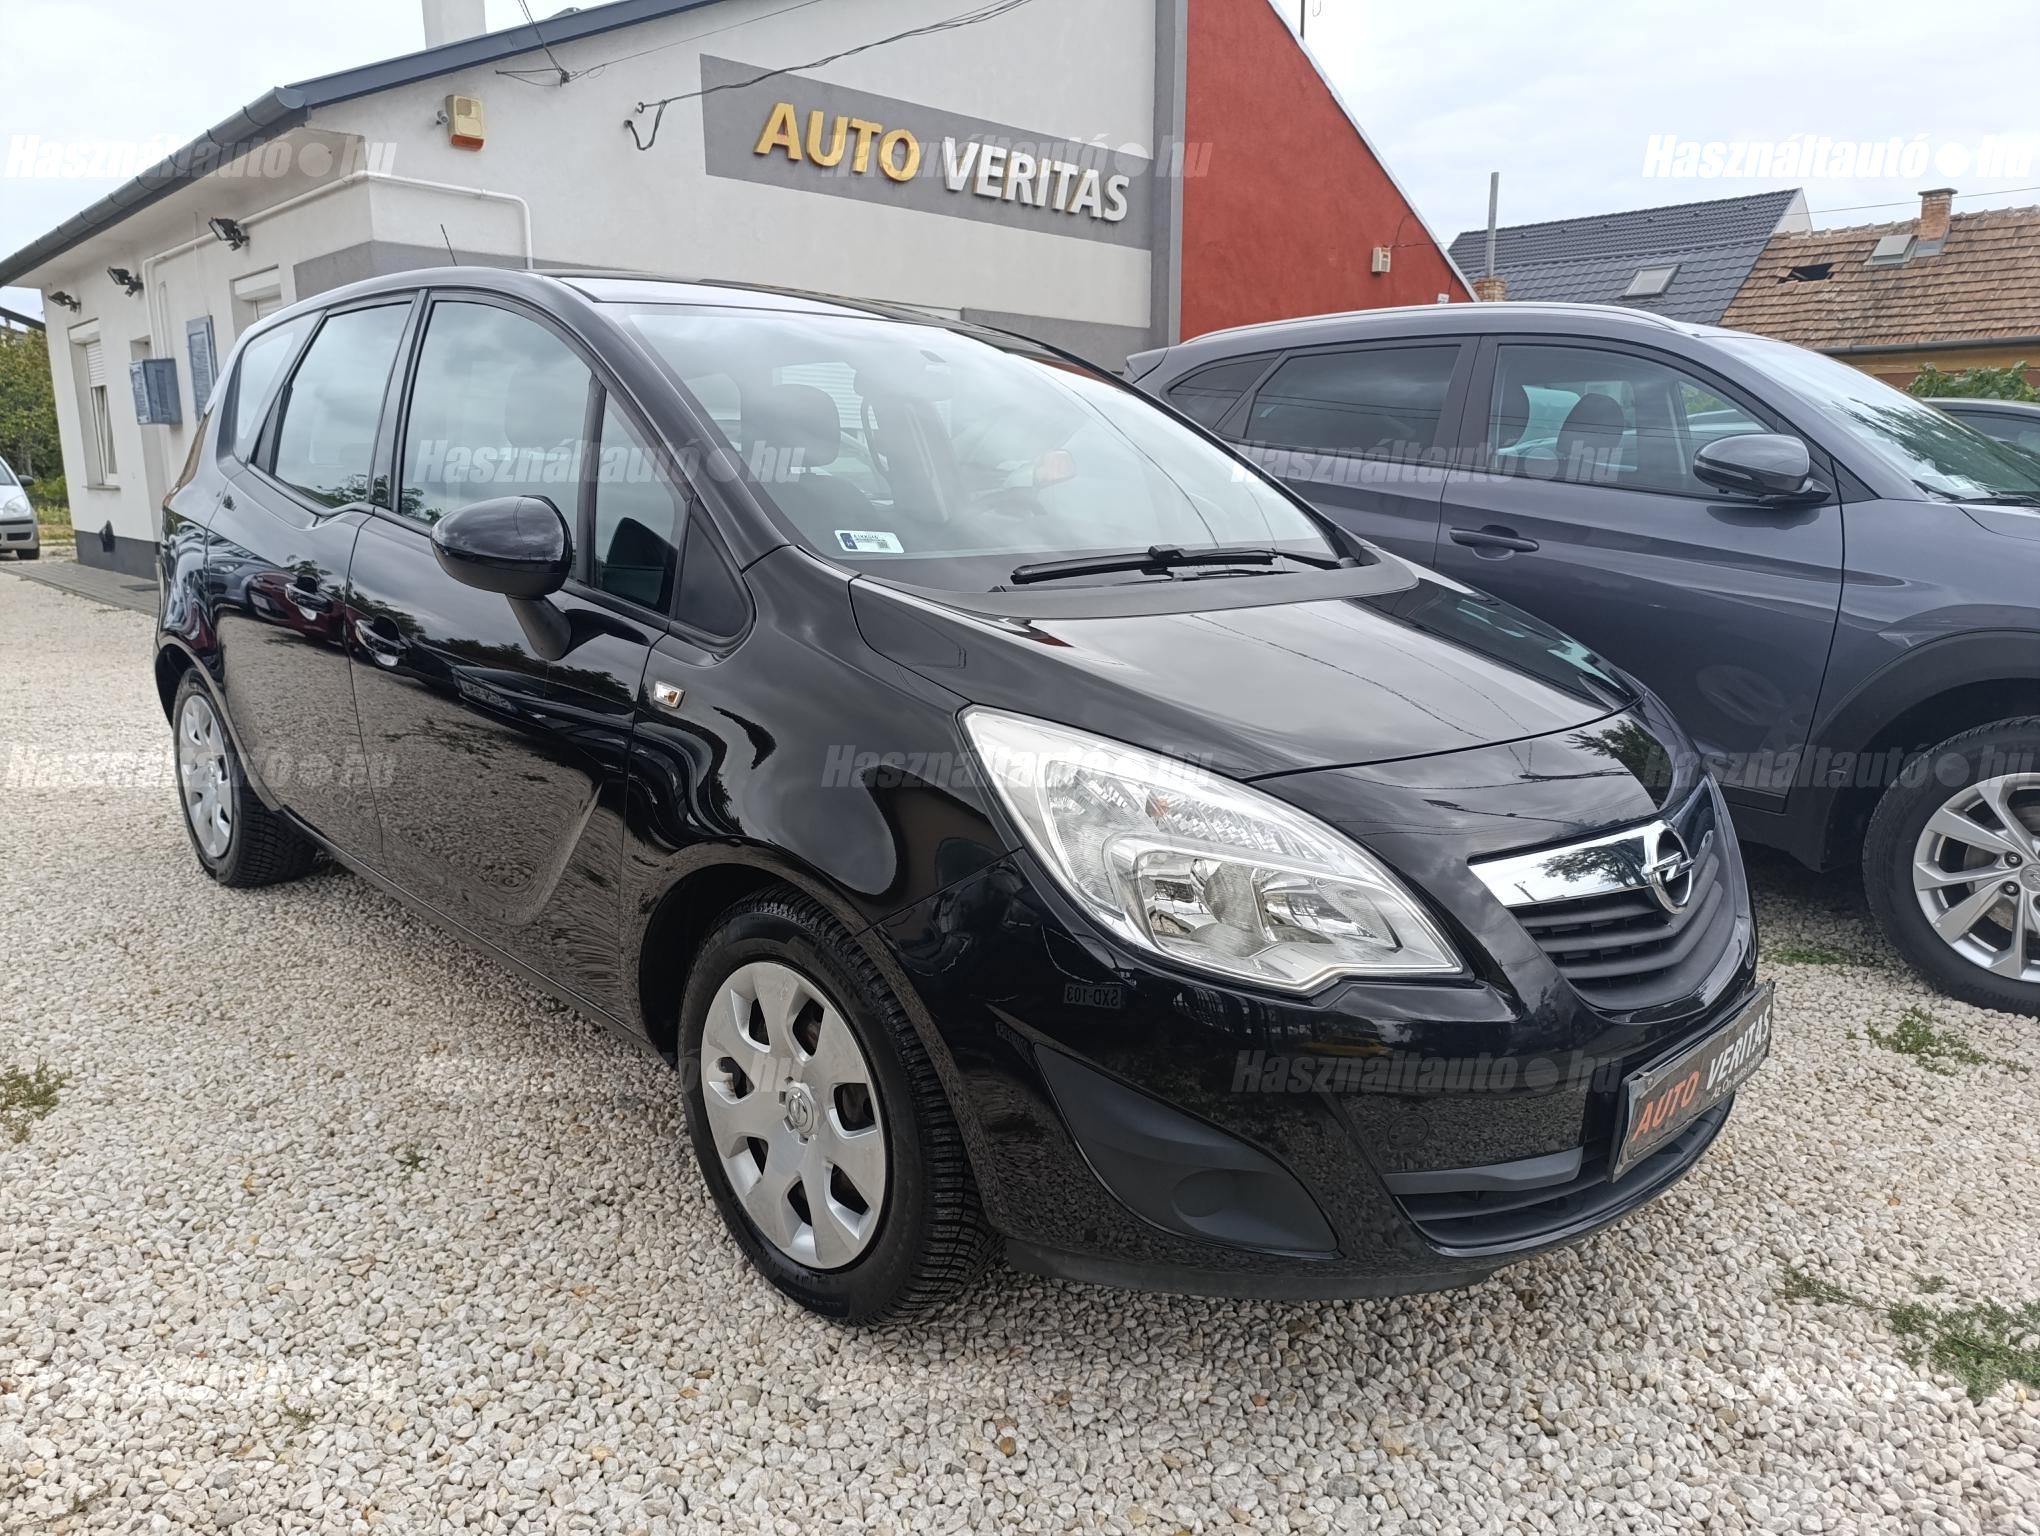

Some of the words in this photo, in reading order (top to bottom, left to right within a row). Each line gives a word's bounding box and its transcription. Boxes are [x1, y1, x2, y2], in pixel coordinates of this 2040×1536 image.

[754, 102, 921, 182] AUTO
[942, 136, 1130, 222] VERITAS
[1632, 1071, 1700, 1142] AUTO
[1706, 1004, 1771, 1090] VERITAS
